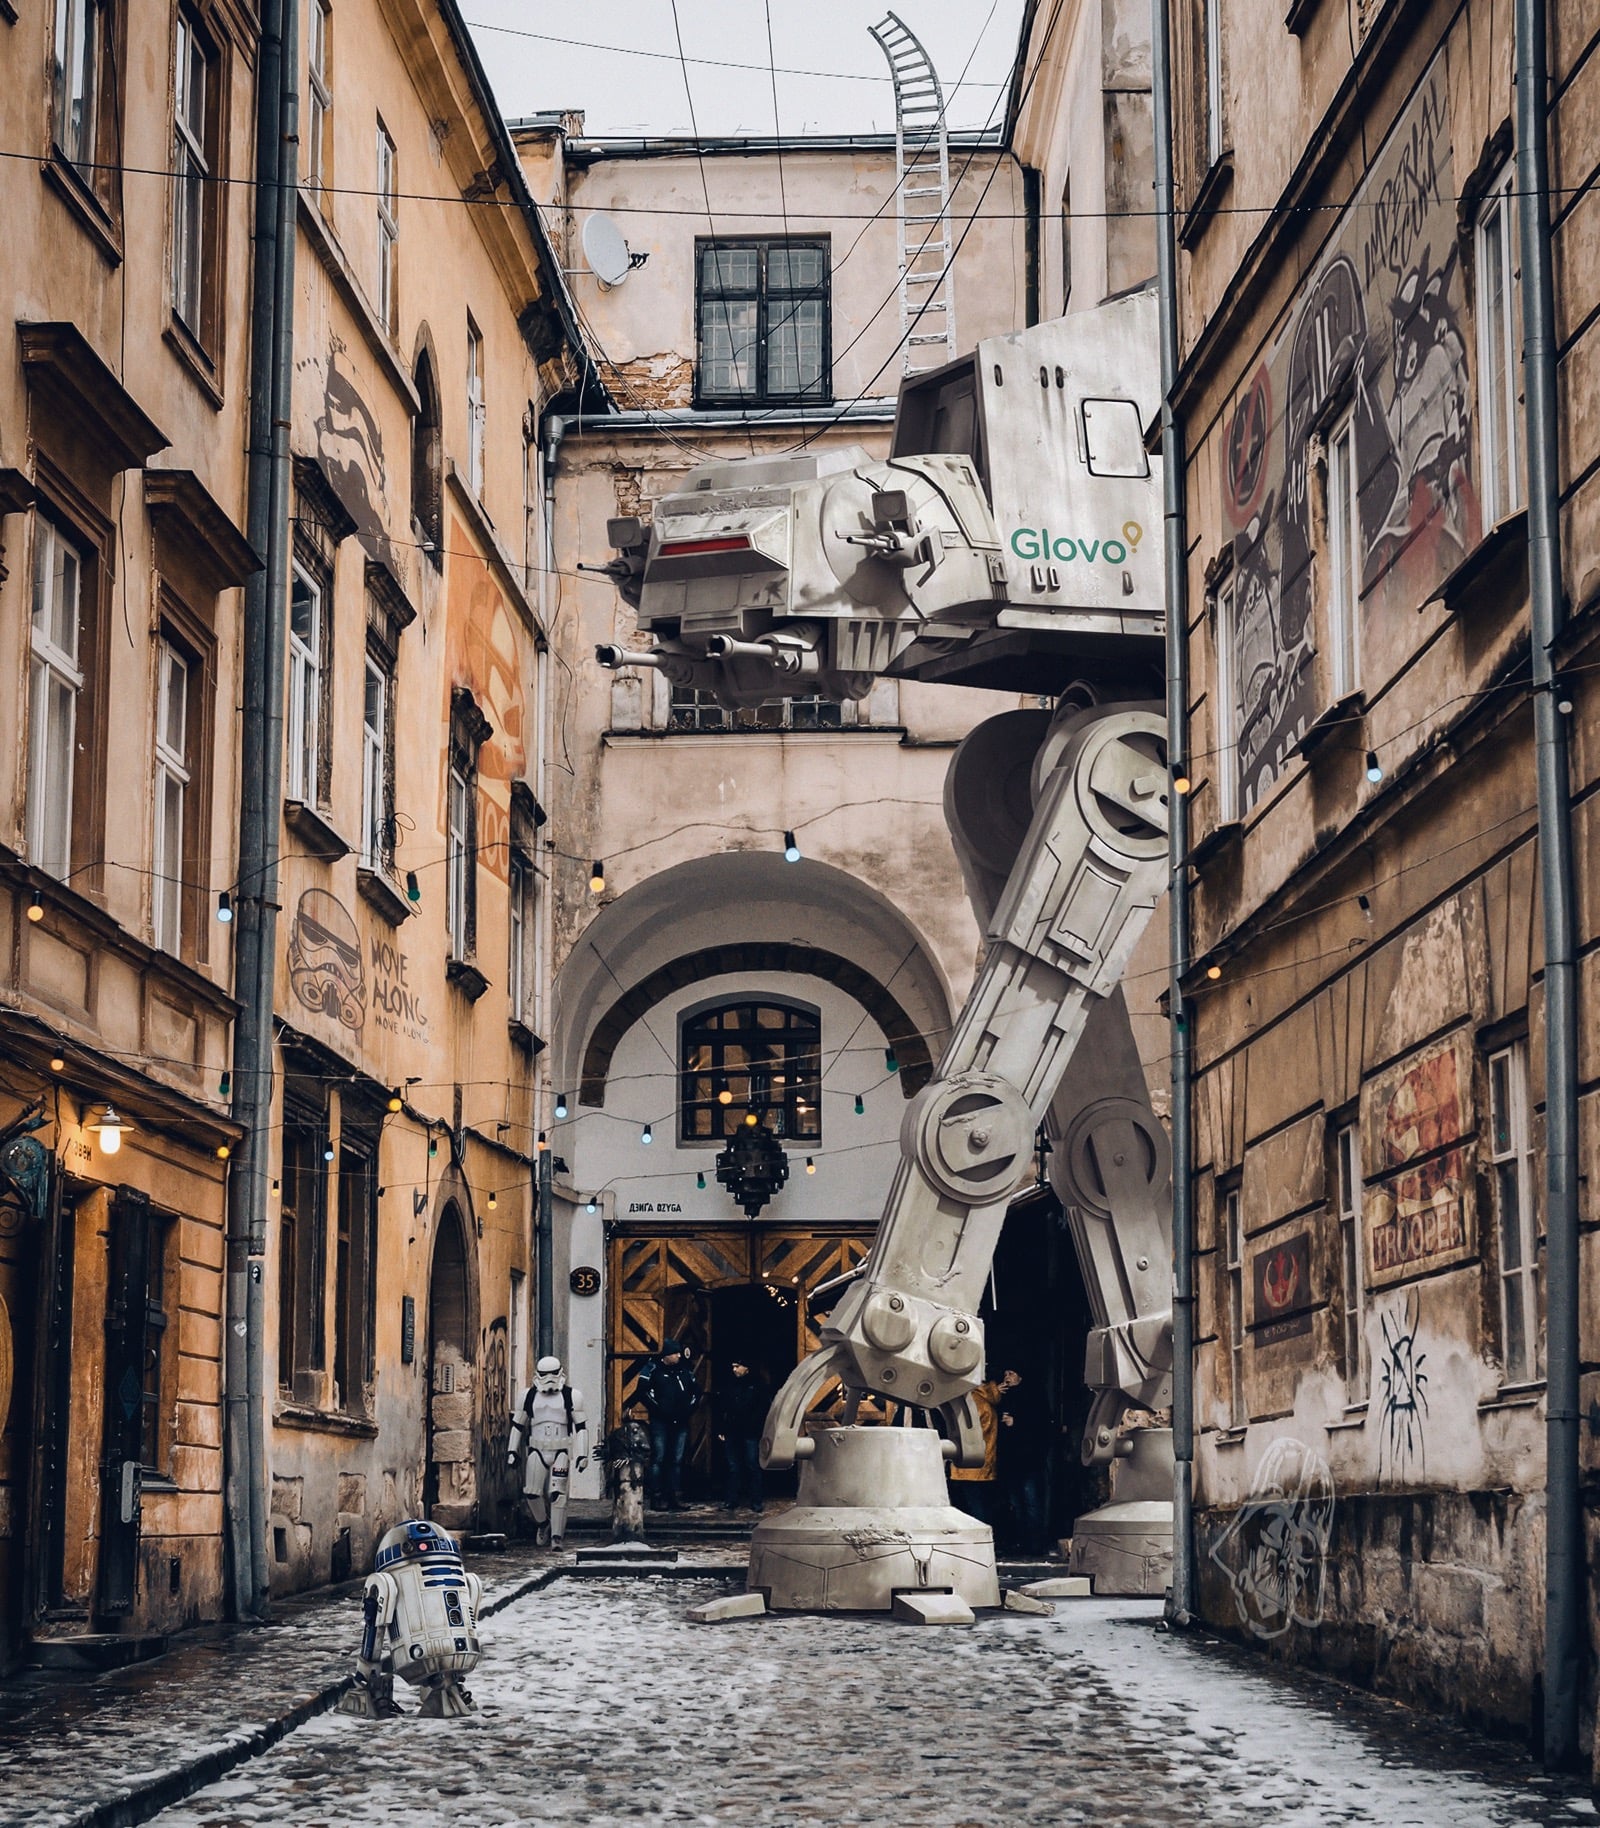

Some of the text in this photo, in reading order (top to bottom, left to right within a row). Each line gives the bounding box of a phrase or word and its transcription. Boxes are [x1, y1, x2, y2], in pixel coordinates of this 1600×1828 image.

[1364, 78, 1448, 294] IMPERIAL
[1389, 138, 1441, 298] SCUM
[1010, 527, 1127, 565] Glovo
[370, 936, 409, 988] MOVE
[372, 975, 428, 1026] ALONG
[375, 1014, 400, 1036] MOVE
[656, 1202, 682, 1213] DZYGA
[1375, 1201, 1464, 1267] TROOPER
[577, 1273, 594, 1289] 35
